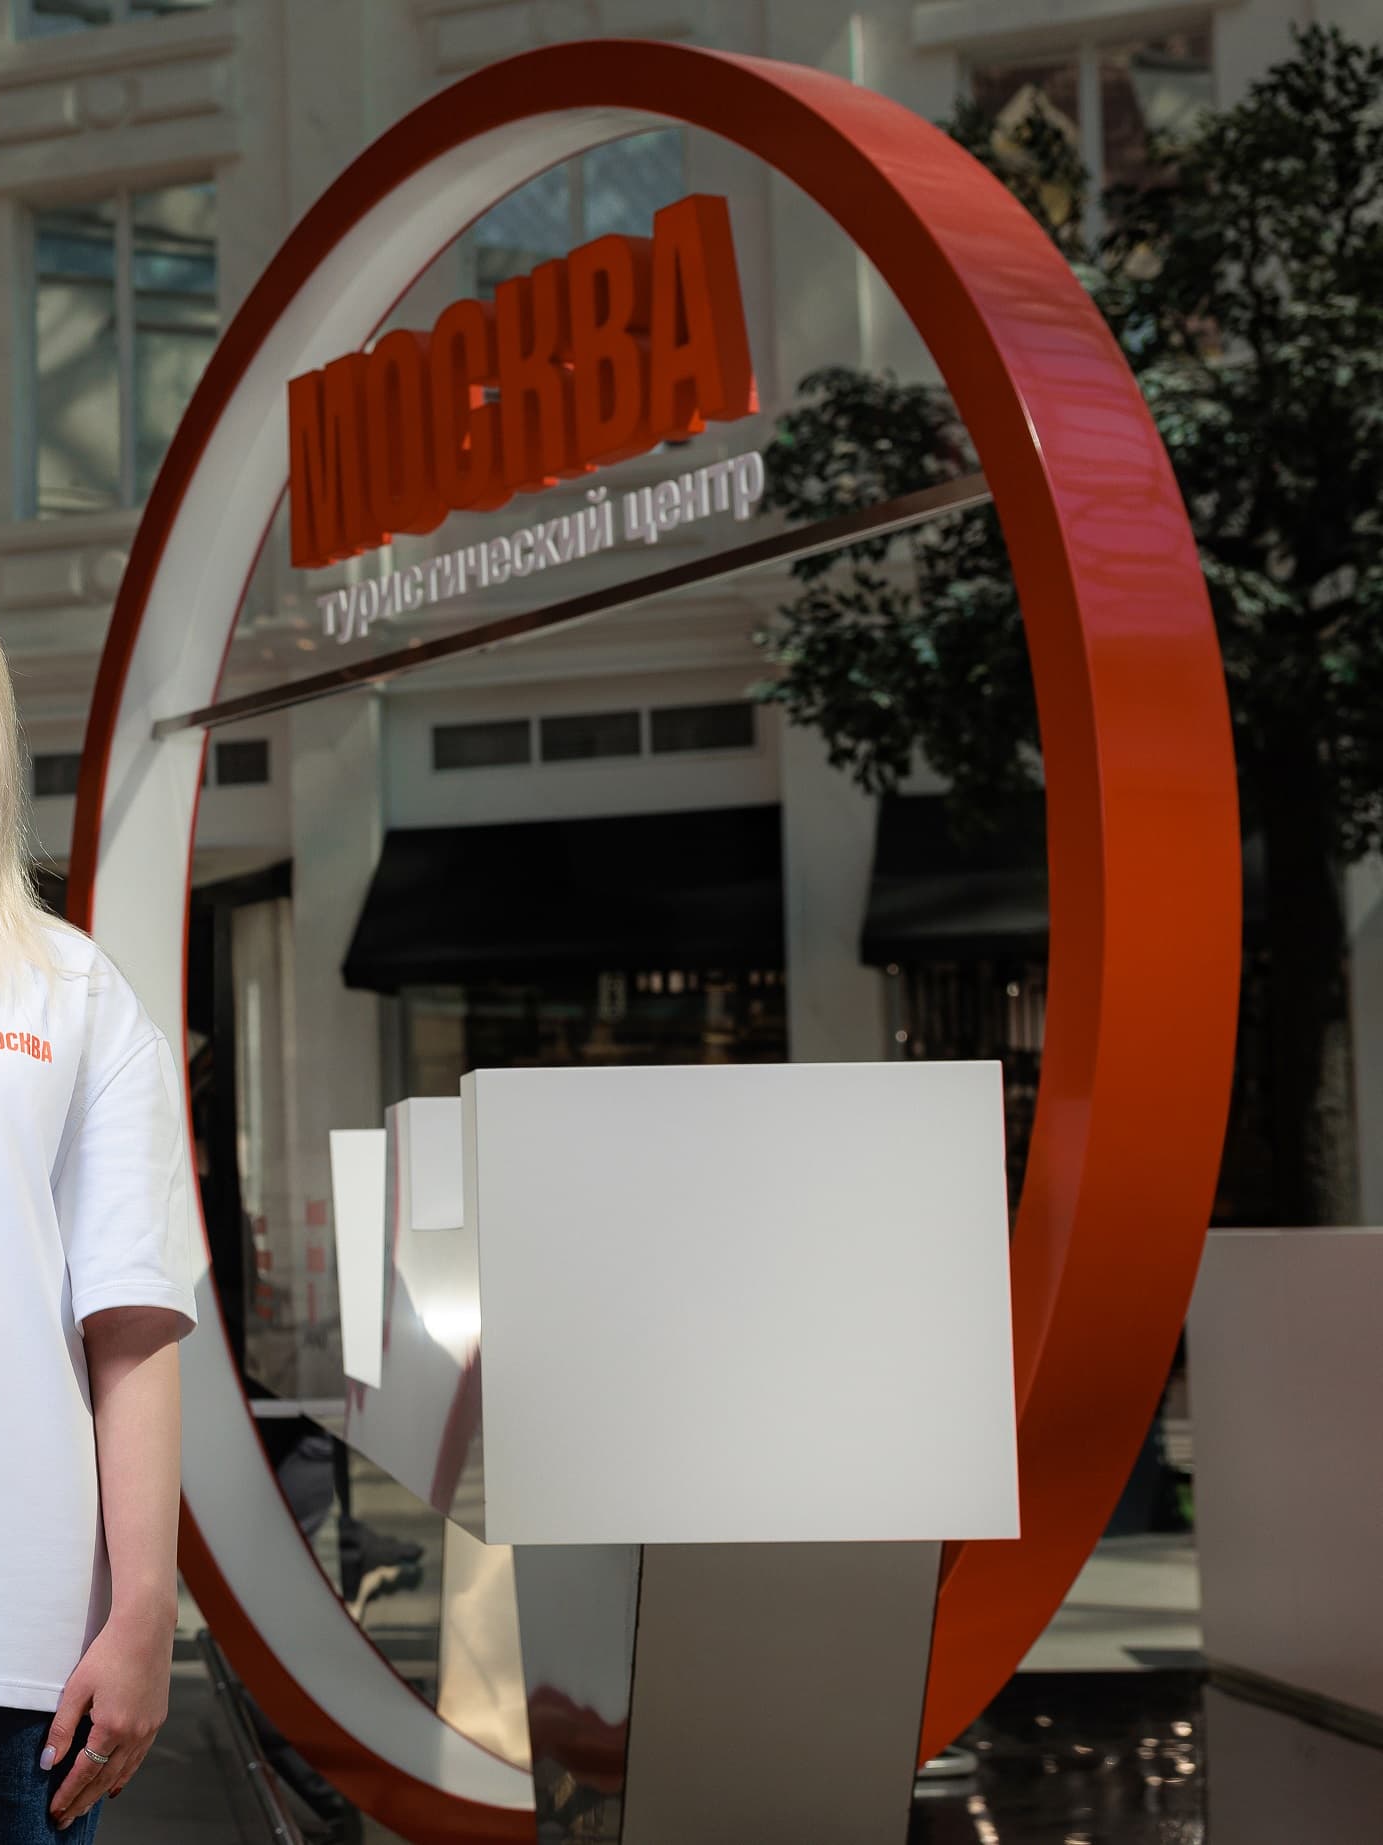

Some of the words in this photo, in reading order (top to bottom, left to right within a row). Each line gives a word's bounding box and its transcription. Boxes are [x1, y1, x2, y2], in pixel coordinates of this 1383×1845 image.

[288, 193, 759, 569] МОСКВА
[318, 485, 614, 644] туристический
[623, 451, 765, 544] центр
